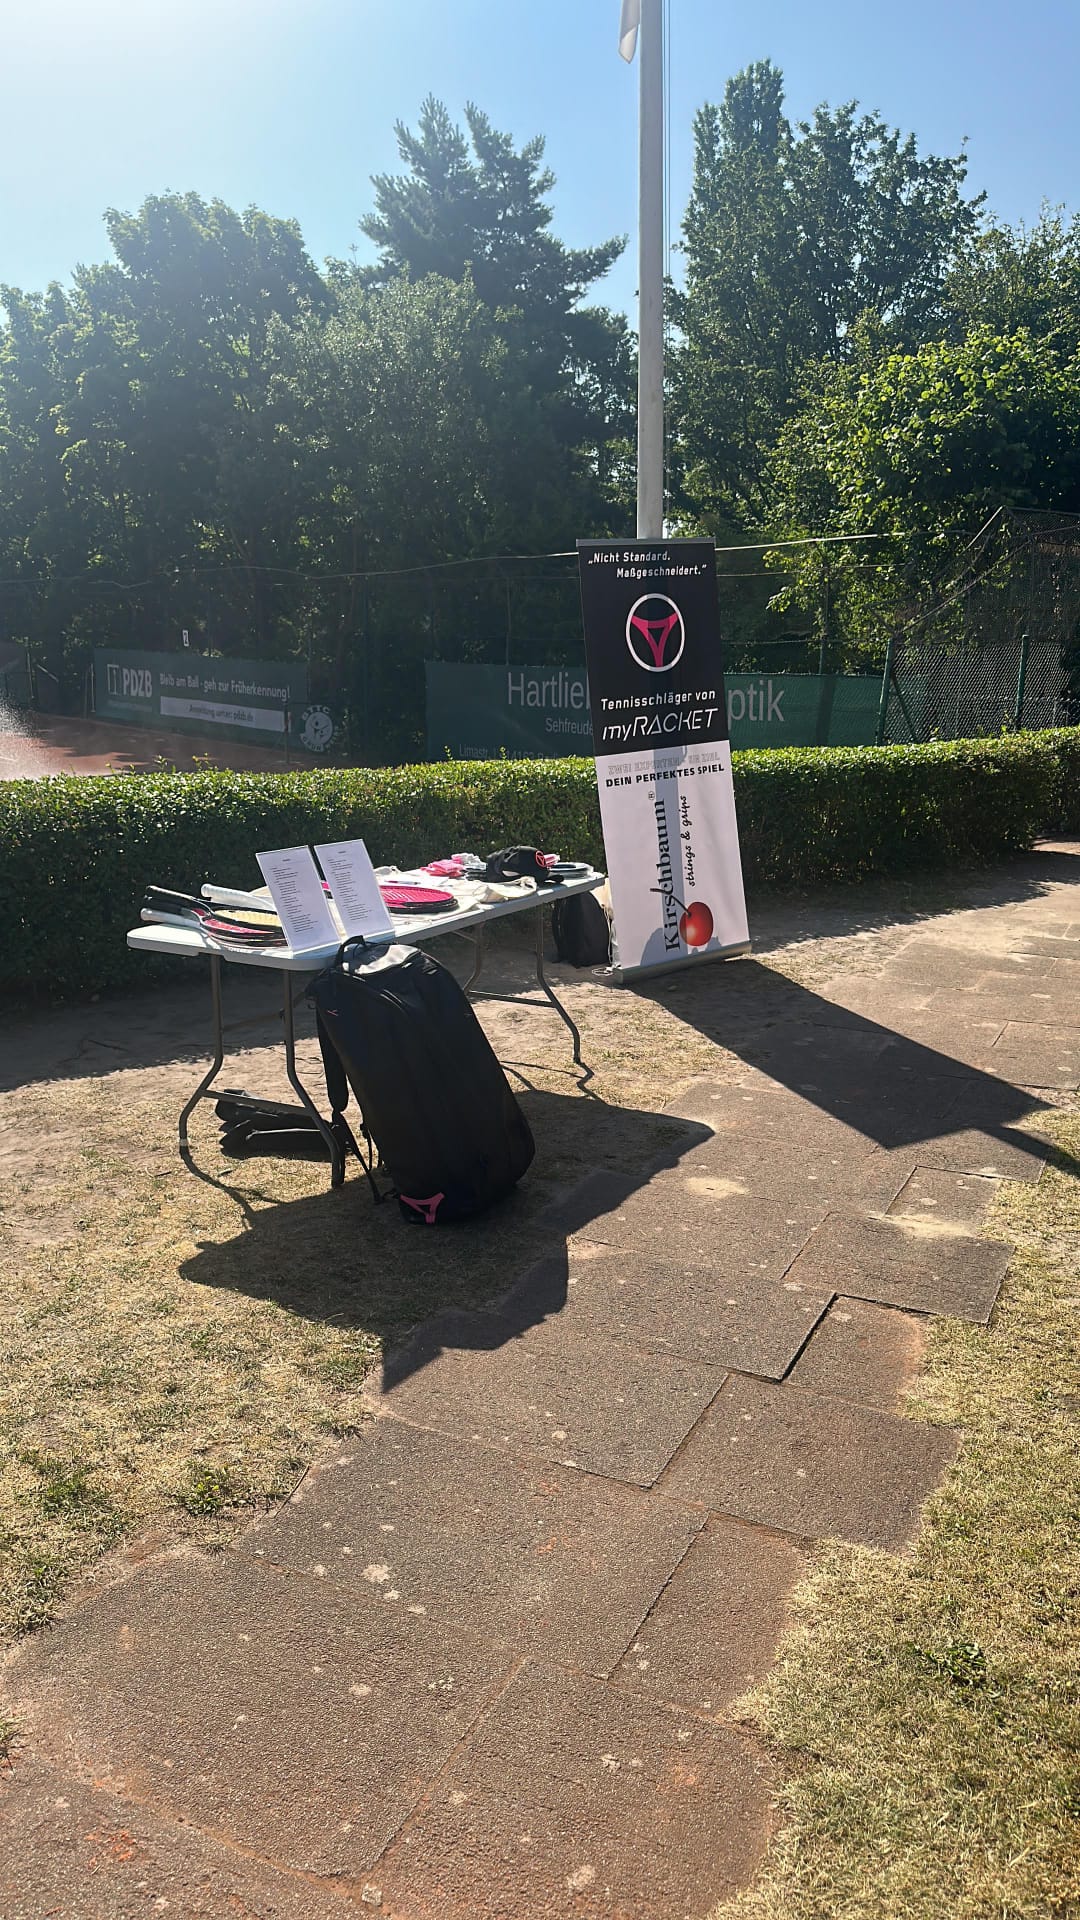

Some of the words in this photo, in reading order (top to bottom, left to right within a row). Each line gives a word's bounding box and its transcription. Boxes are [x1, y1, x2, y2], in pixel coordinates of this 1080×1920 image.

[623, 551, 671, 562] Standard.
[122, 667, 152, 698] PDZB
[176, 677, 186, 687] am
[187, 675, 199, 688] Ball
[204, 678, 217, 693] geh
[218, 682, 229, 692] zur
[231, 680, 290, 701] Früherkennung!
[600, 692, 692, 711] Tennisschläger
[695, 690, 716, 701] von
[728, 679, 785, 731] ptik
[602, 707, 719, 742] myRACKET
[606, 776, 632, 788] DEIN
[635, 767, 695, 783] PERFEKTES
[697, 763, 725, 775] SPIEL
[678, 795, 692, 827] grips
[680, 830, 690, 840] &
[654, 798, 680, 952] Kirschbaum
[684, 845, 696, 887] strings
